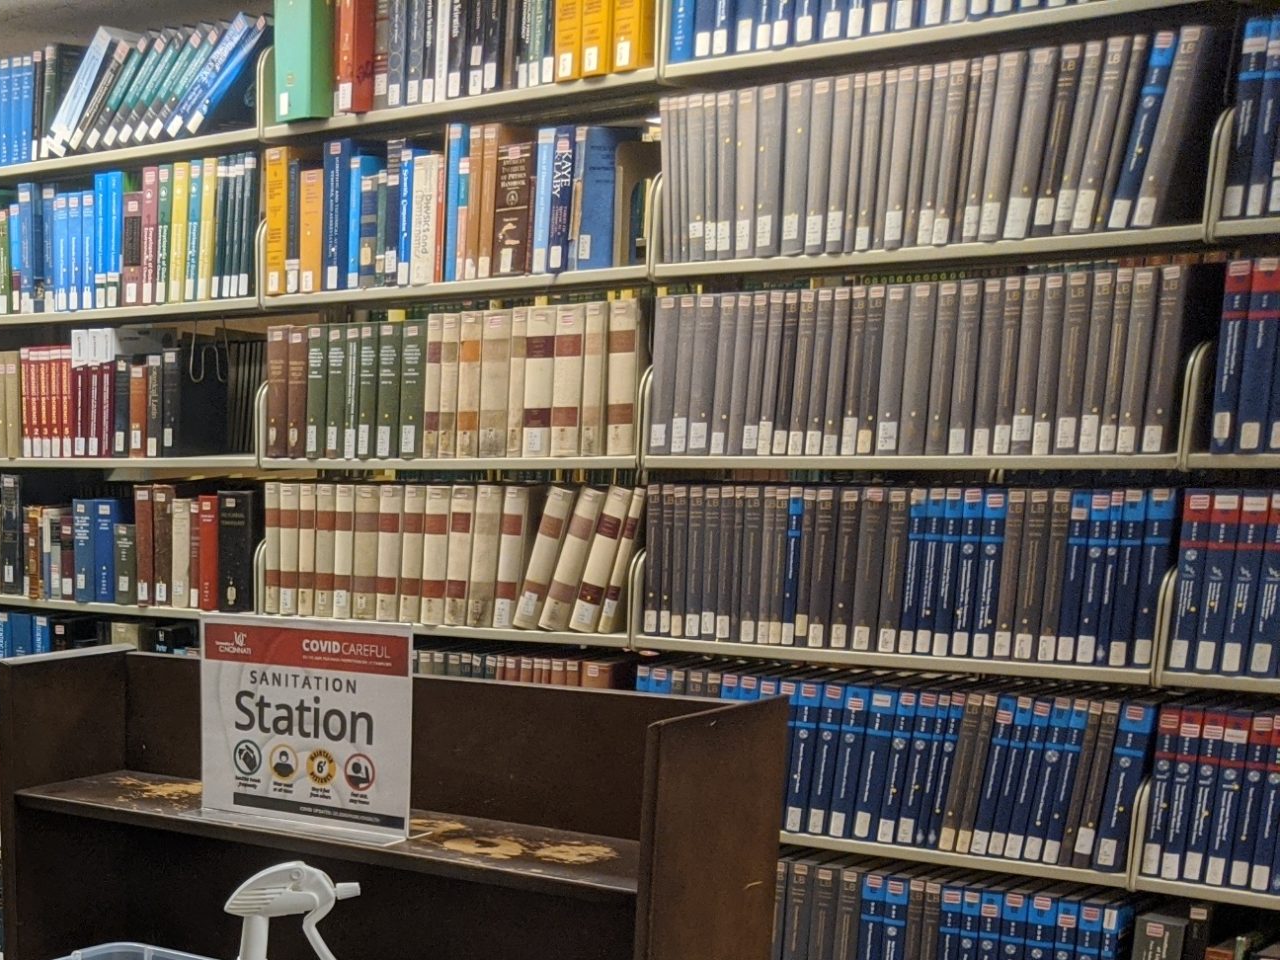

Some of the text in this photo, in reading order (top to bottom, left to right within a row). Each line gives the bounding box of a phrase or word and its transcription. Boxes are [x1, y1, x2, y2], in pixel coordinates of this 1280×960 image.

[552, 161, 561, 198] LABY
[560, 149, 572, 187] KAYE
[250, 670, 357, 694] SANITATION
[234, 690, 374, 746] Station
